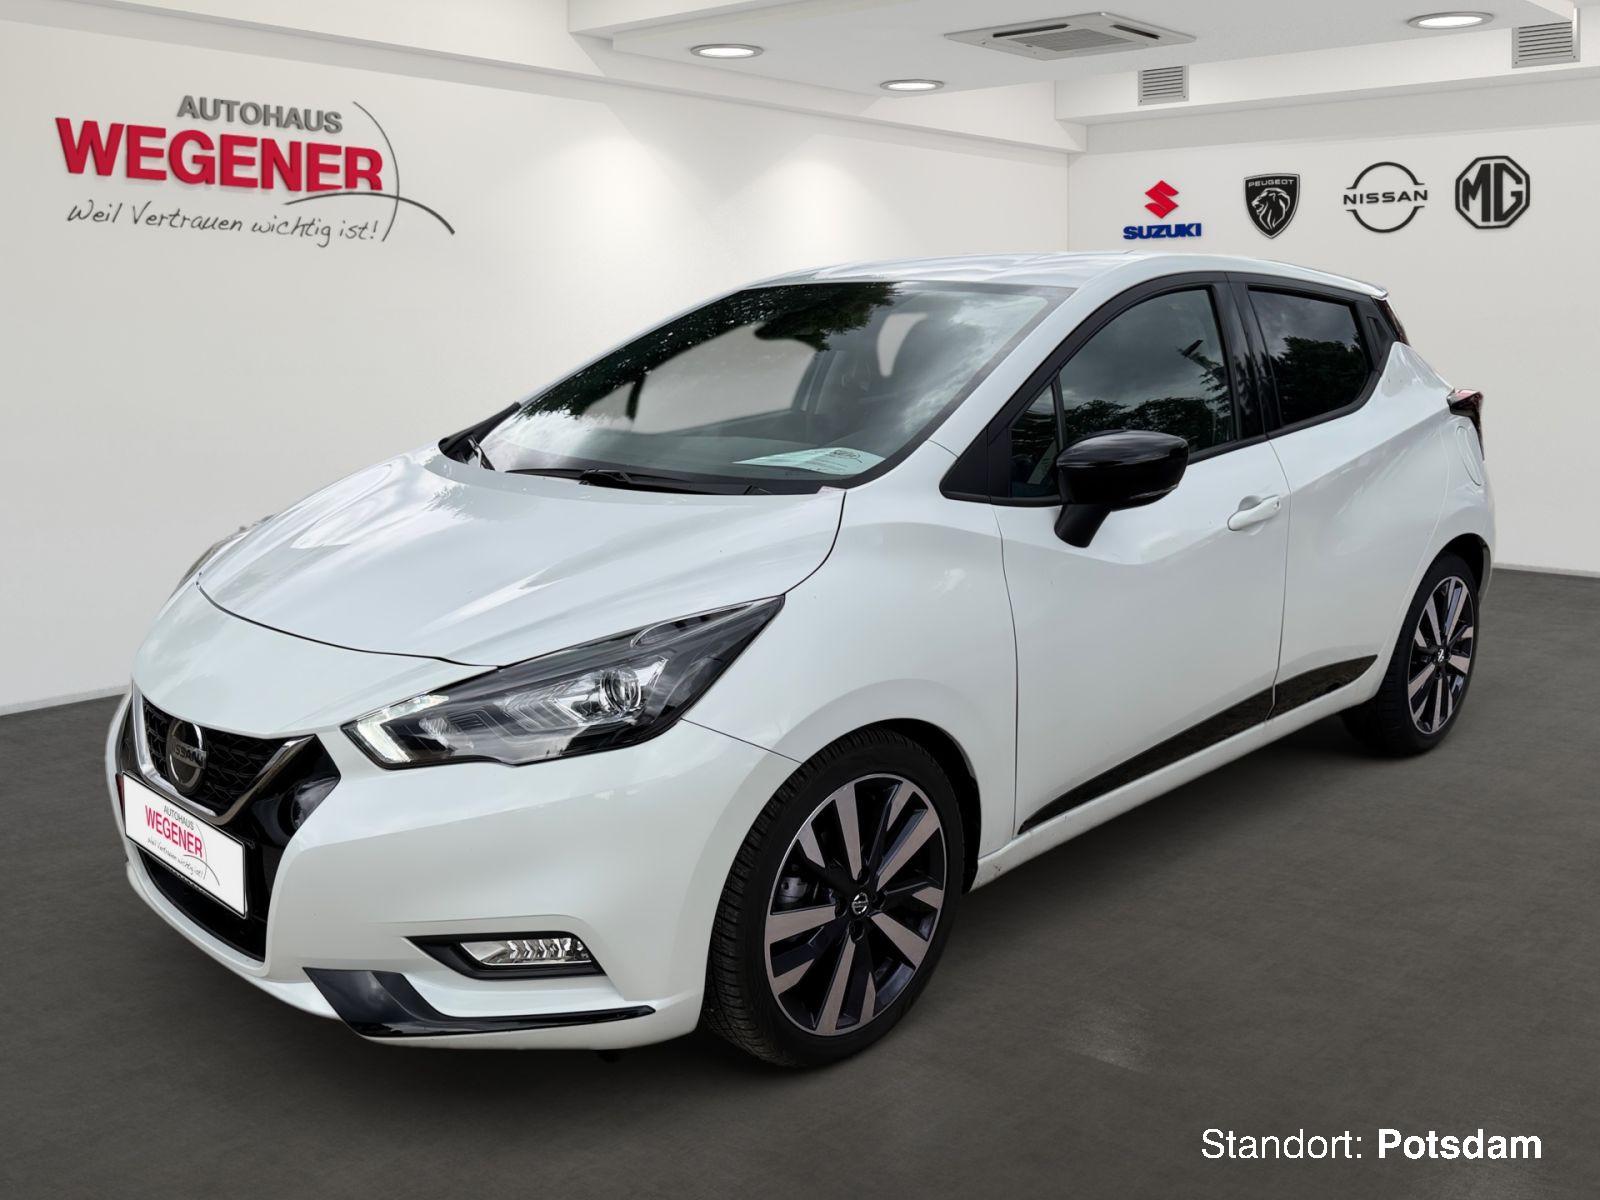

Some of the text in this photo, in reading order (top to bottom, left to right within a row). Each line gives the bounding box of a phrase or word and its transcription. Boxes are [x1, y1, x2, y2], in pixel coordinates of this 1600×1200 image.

[177, 95, 343, 134] AUTOHAUS
[55, 117, 384, 192] WEGENER
[1248, 179, 1295, 188] PEUGEOT
[1343, 189, 1428, 205] NISSAN
[1462, 162, 1524, 223] MG
[66, 199, 378, 248] Weil Vertrauen wichtig ist!
[1123, 222, 1203, 240] SUZUKI
[145, 805, 203, 858] WEGENER
[163, 805, 194, 831] AUTOHAUS
